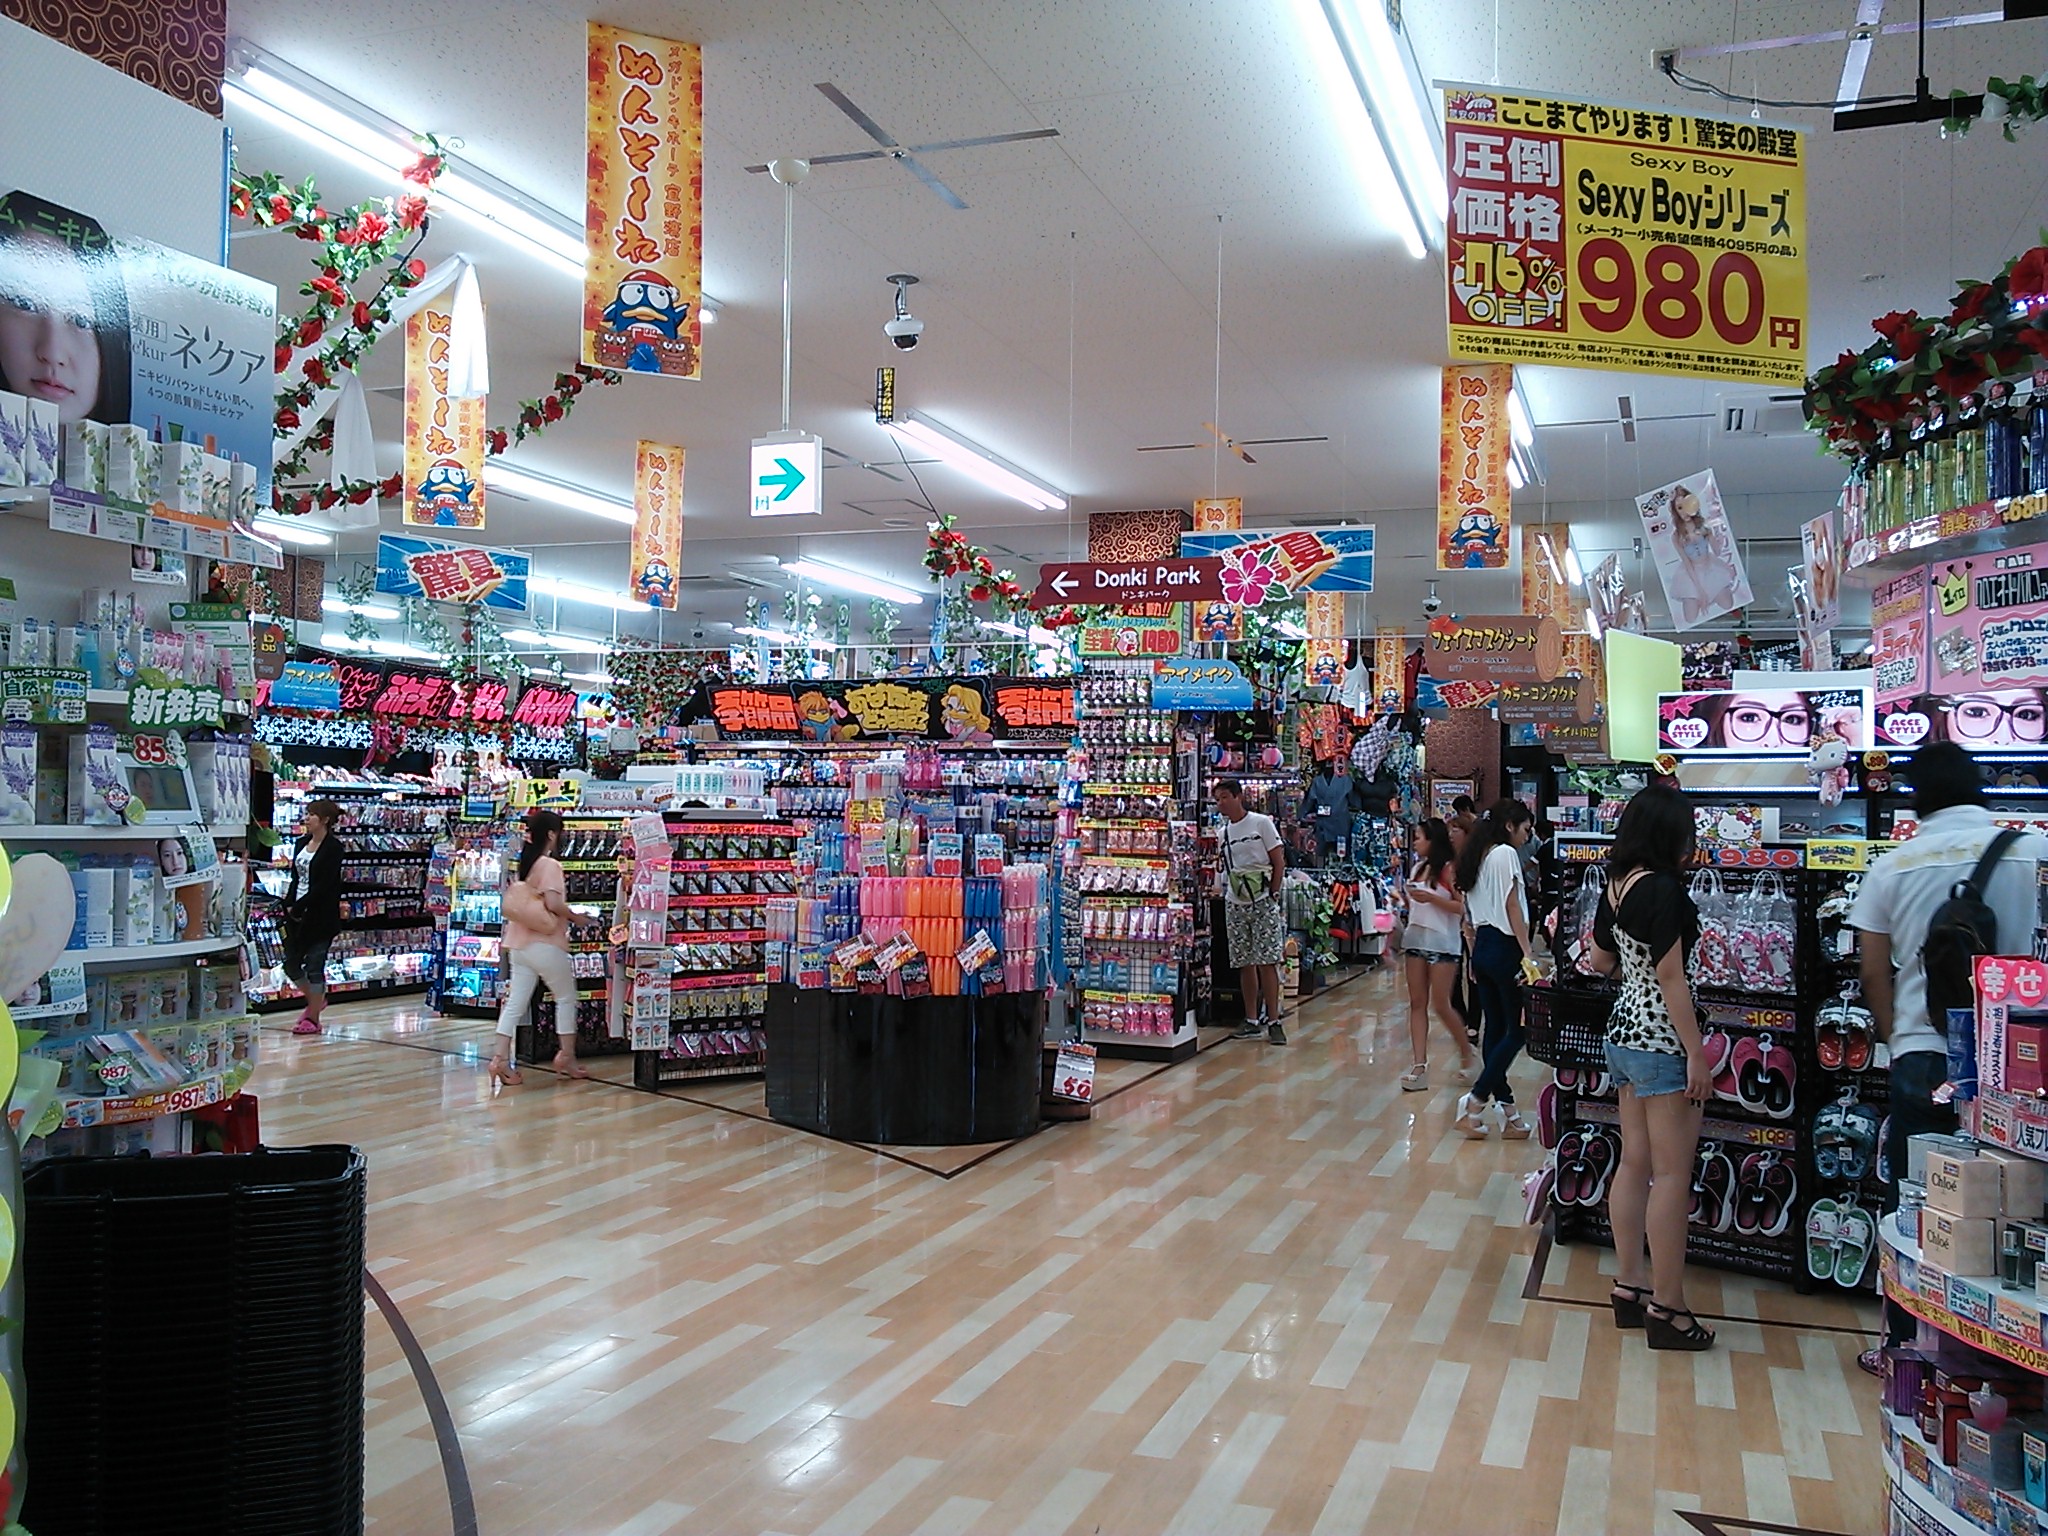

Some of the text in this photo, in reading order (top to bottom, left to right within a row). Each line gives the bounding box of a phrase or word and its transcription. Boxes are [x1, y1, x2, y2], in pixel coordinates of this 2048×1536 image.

[617, 44, 663, 265] めんそーれ
[1452, 131, 1561, 188] 圧倒
[1630, 152, 1735, 178] Sexy Boy
[1577, 168, 1646, 224] Sexy
[1452, 187, 1562, 243] 価格
[1457, 375, 1488, 506] めんそーれ
[1094, 565, 1201, 589] Donki Park
[1120, 588, 1171, 600] ドンキパーク
[1159, 666, 1235, 685] アイメイク
[131, 685, 222, 724] 新発売
[1502, 685, 1579, 702] カラーコンタクト
[714, 690, 799, 732] 季節品
[1674, 723, 1701, 731] ACCE
[1888, 725, 1924, 735] STYLE
[1890, 718, 1921, 727] ACCE
[1671, 730, 1703, 739] STYLE
[1568, 845, 1597, 860] Hello
[1718, 849, 1799, 867] 980
[1981, 961, 2043, 999] 幸せ
[1931, 1172, 1958, 1192] Chloé
[1926, 1228, 1951, 1250] Chloé
